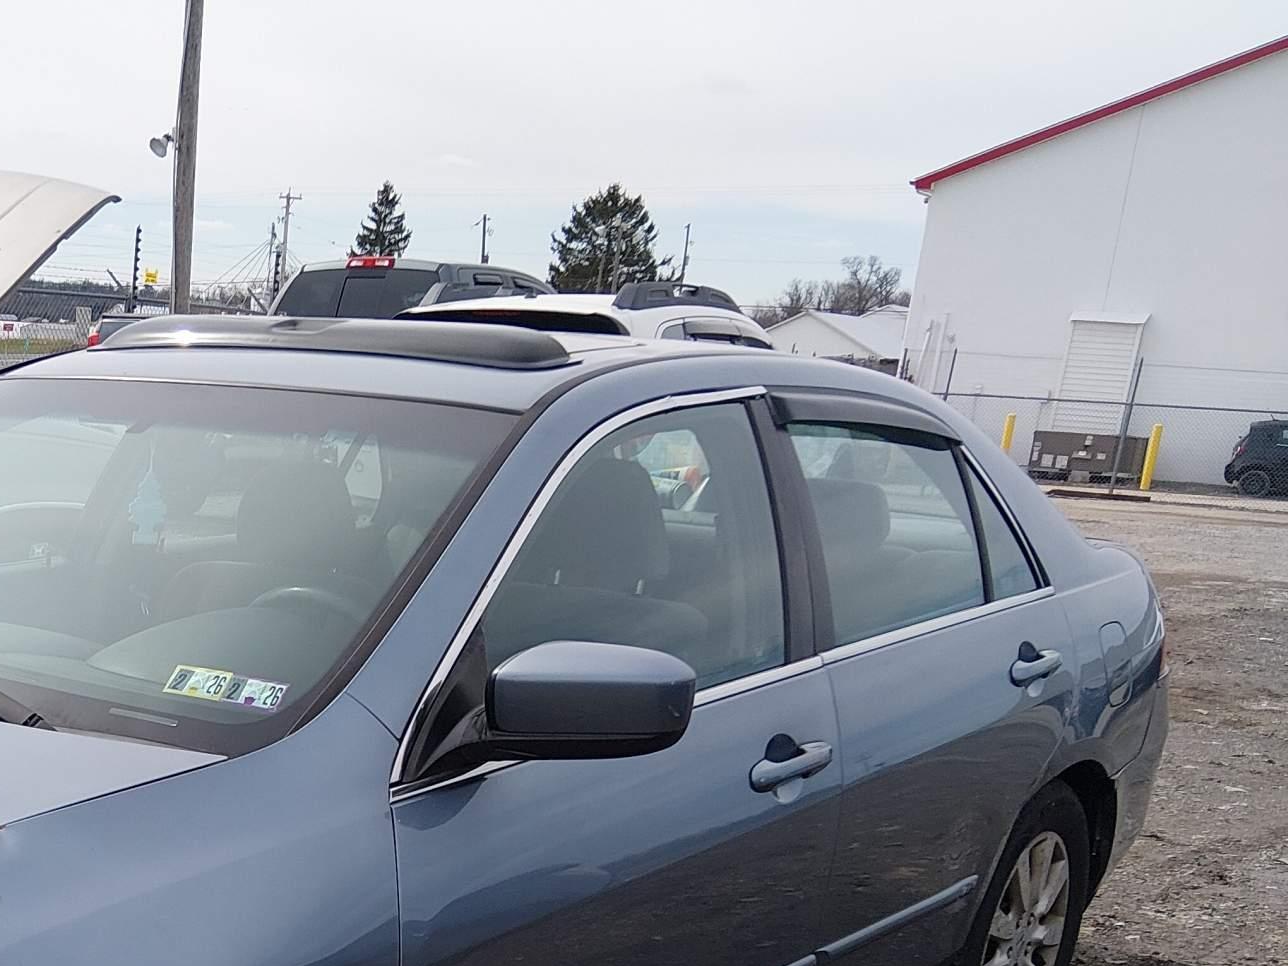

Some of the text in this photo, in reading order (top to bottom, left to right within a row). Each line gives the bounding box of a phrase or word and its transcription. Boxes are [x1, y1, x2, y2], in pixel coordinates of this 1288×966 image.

[172, 673, 227, 695] 2 26
[226, 682, 283, 707] 2 26
